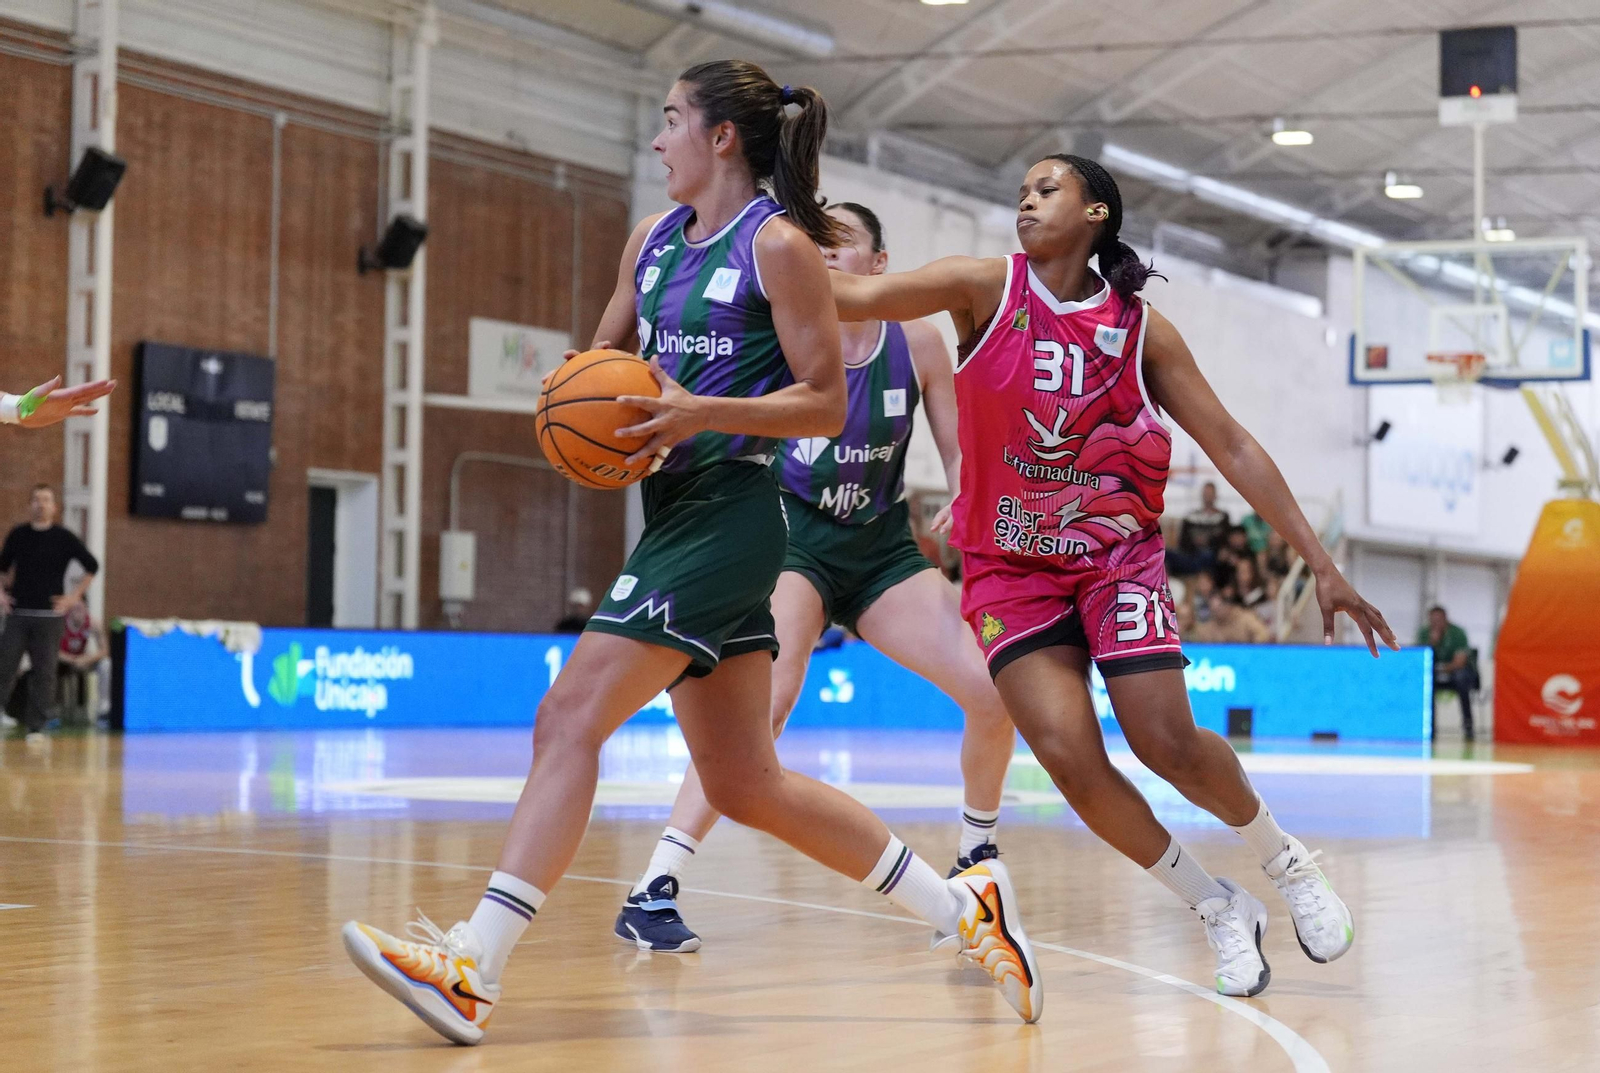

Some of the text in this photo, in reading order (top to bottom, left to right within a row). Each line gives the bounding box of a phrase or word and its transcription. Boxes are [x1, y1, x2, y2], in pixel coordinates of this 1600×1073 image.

[655, 329, 734, 361] Unicaja
[1033, 338, 1086, 397] 31
[1115, 591, 1167, 642] 31
[314, 645, 414, 680] Fundación
[314, 677, 388, 719] Unicaja
